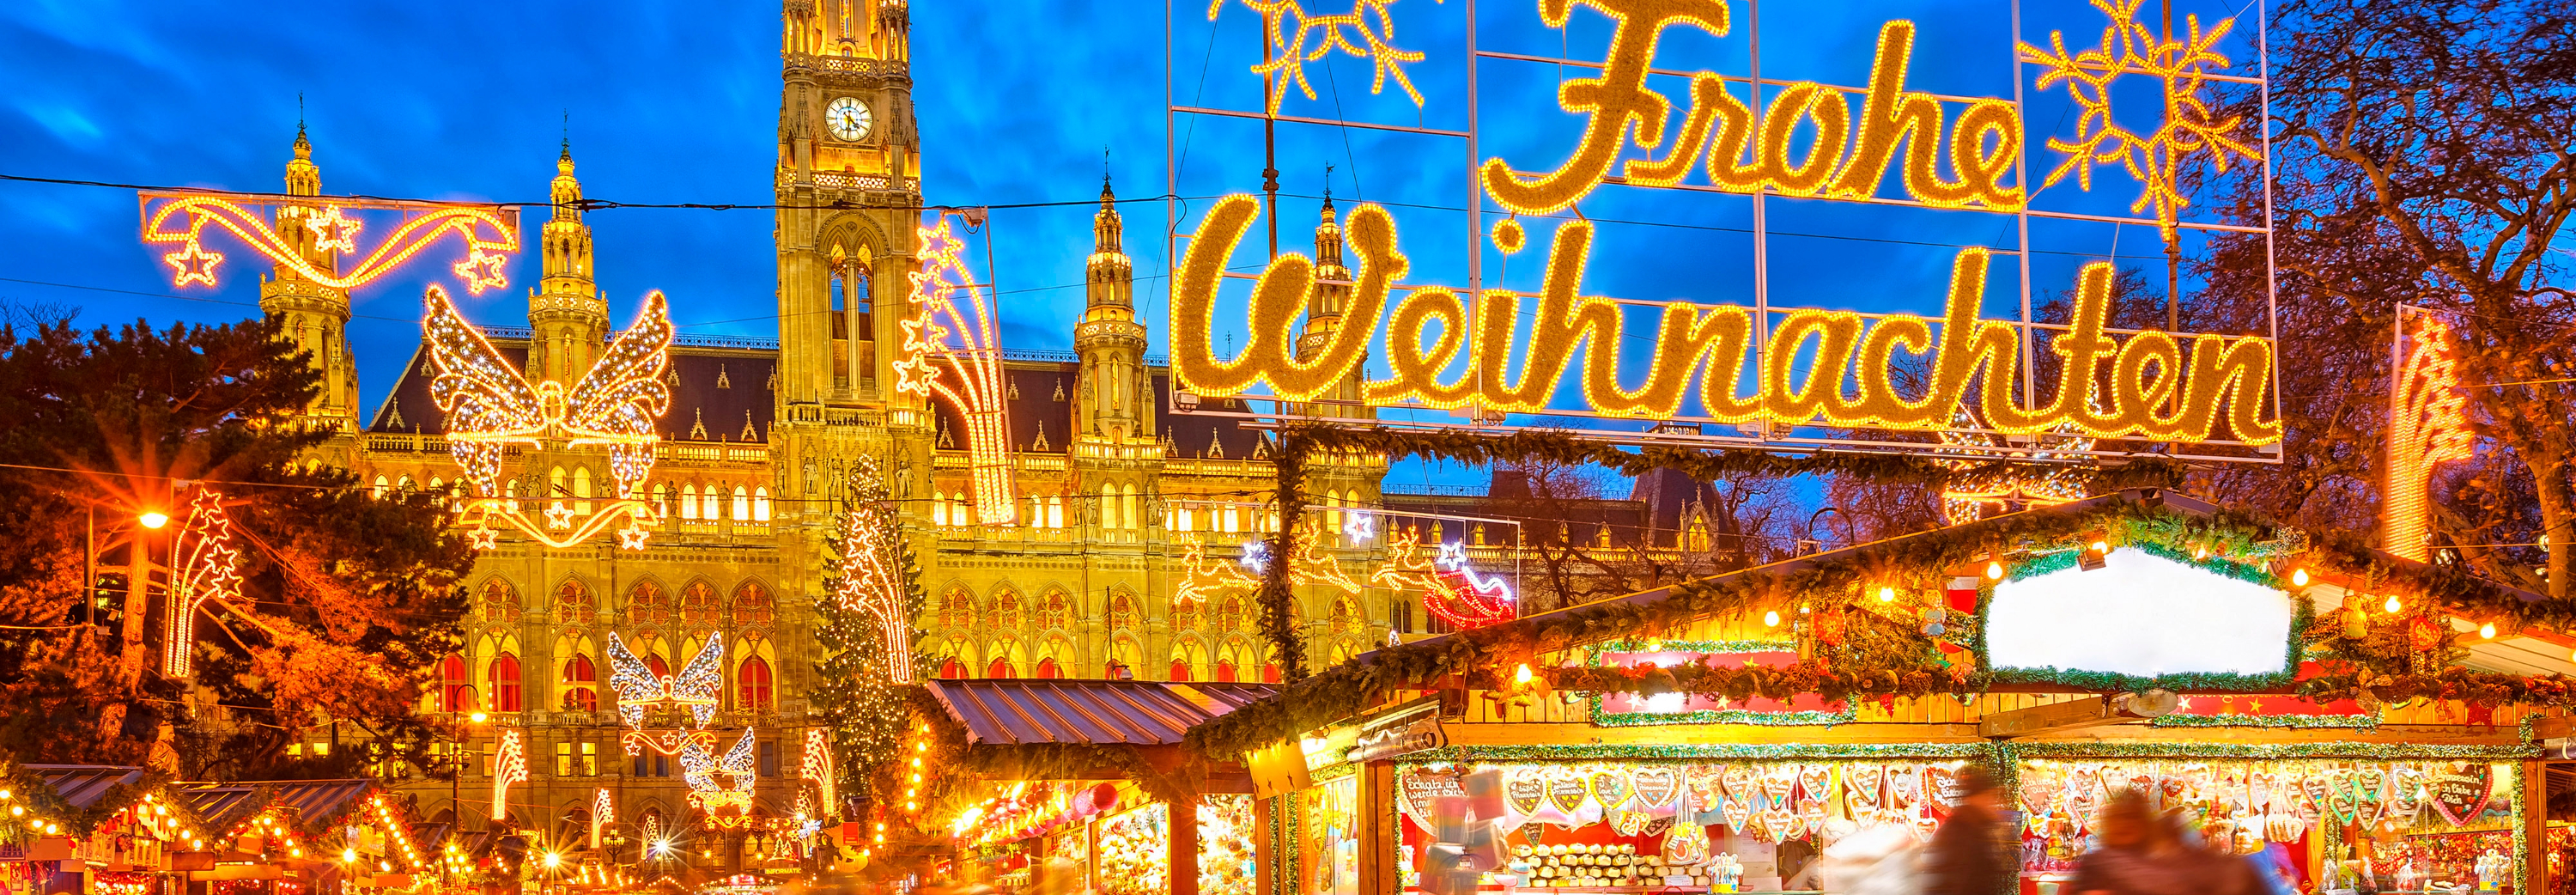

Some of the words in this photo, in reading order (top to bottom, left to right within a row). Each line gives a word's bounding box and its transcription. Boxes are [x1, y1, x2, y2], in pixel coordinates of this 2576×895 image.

[1481, 0, 2025, 215] Frohe
[1170, 193, 2283, 445] Weihnachten
[1408, 788, 1440, 799] werde
[2451, 785, 2472, 795] liebe
[2441, 794, 2463, 804] Dich
